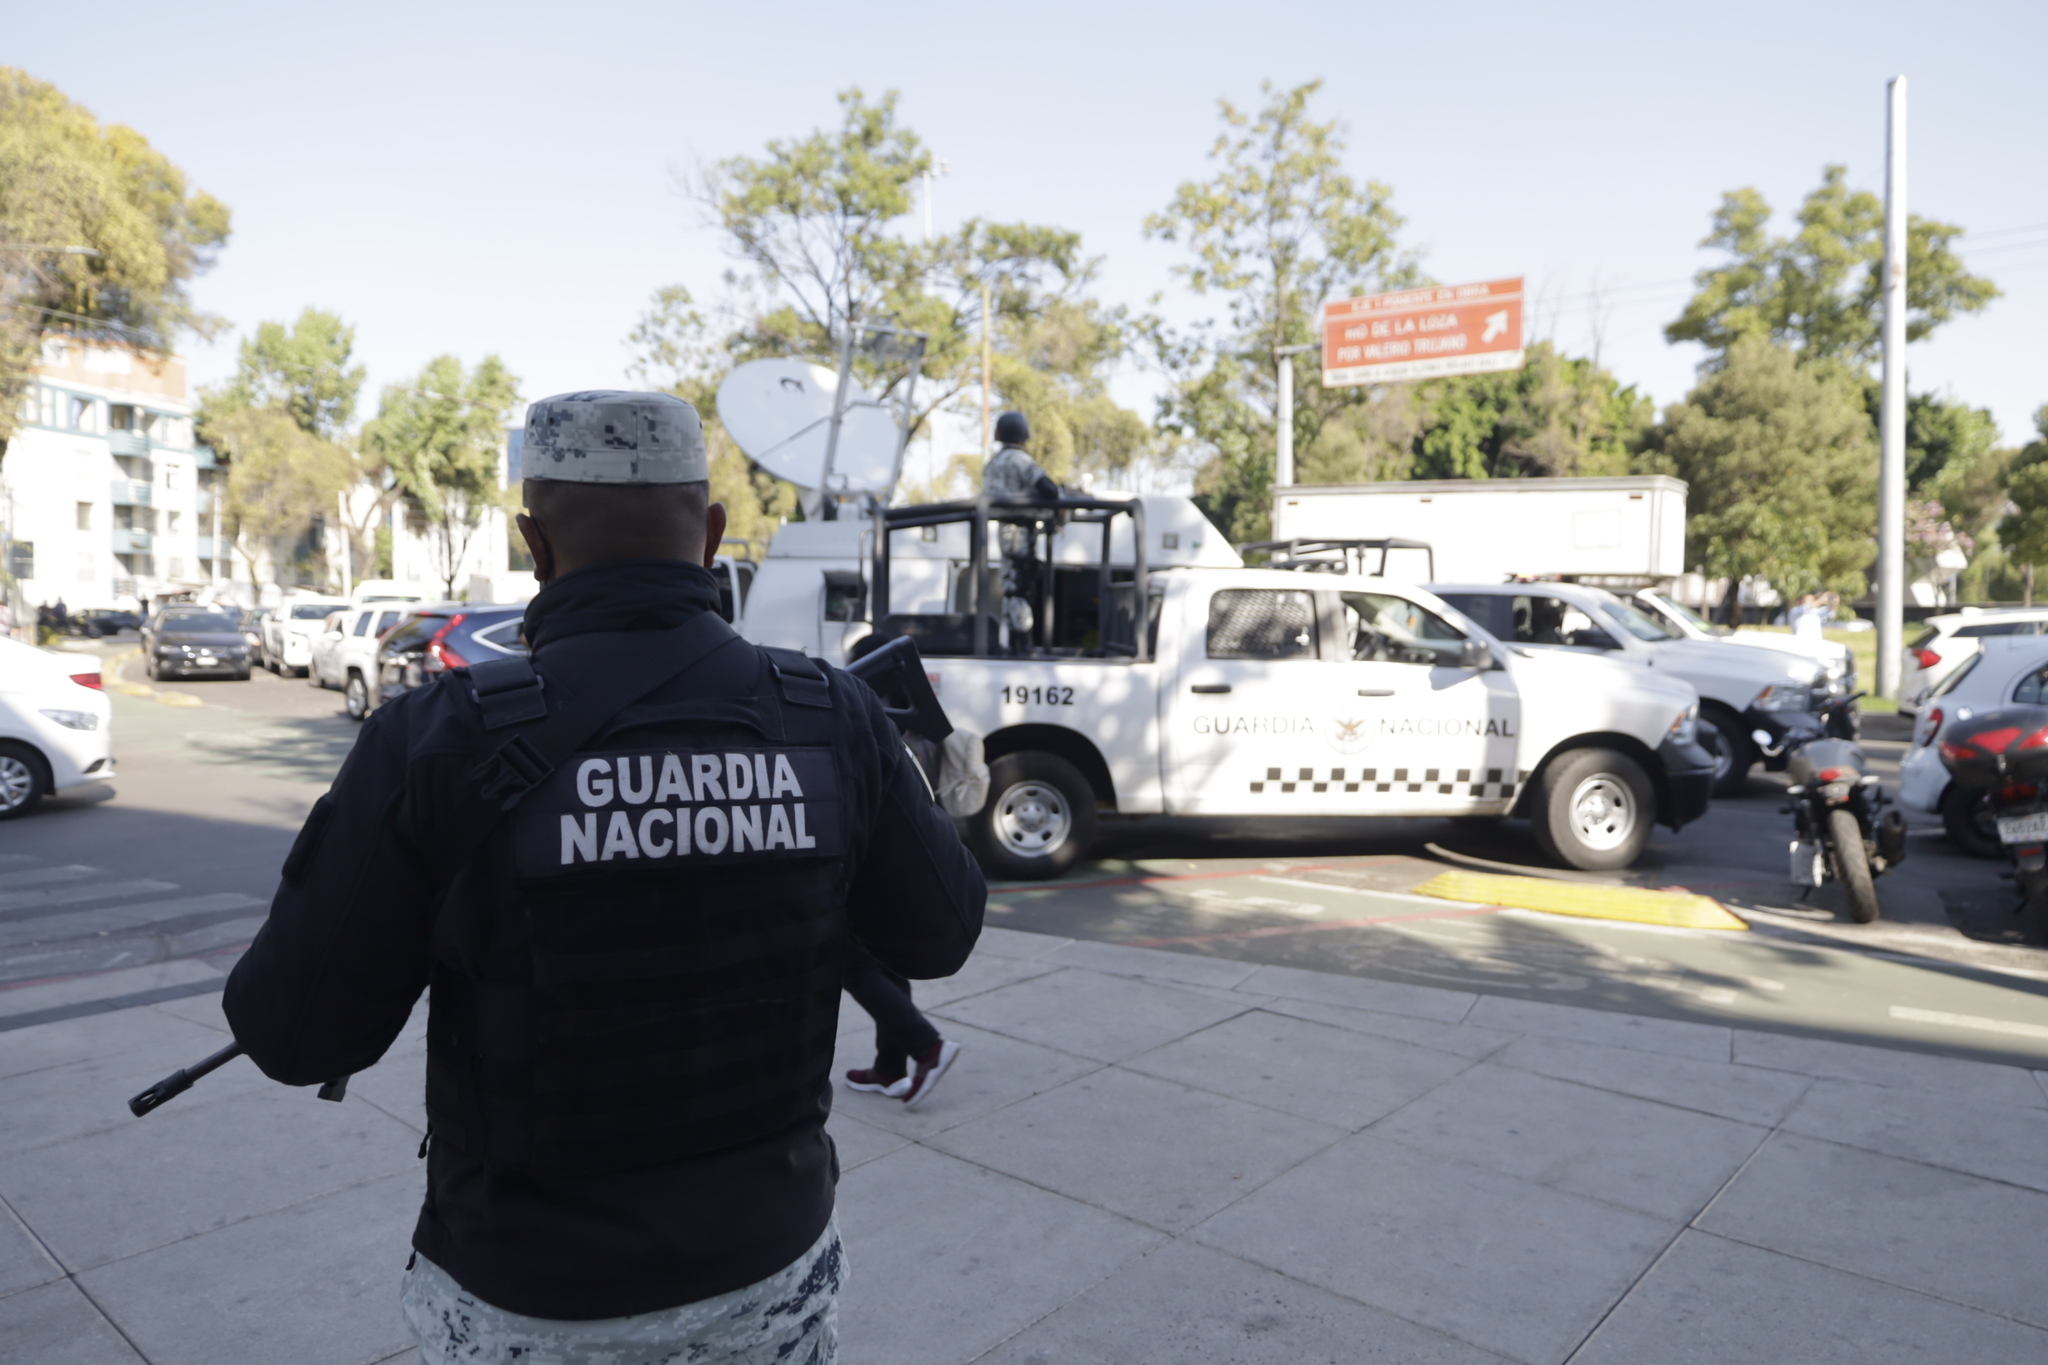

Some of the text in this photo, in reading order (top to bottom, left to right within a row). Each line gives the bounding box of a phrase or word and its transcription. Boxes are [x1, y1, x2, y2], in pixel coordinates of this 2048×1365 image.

[1371, 320, 1391, 338] DE
[1394, 317, 1416, 335] LA
[1419, 313, 1459, 333] LOZA
[1337, 333, 1468, 363] POR VALERIO TRUJANO
[1001, 685, 1074, 706] 19162
[1193, 715, 1515, 737] GUARDIA NACIONAL
[576, 752, 804, 807] GUARDIA
[560, 802, 816, 865] NACIONAL
